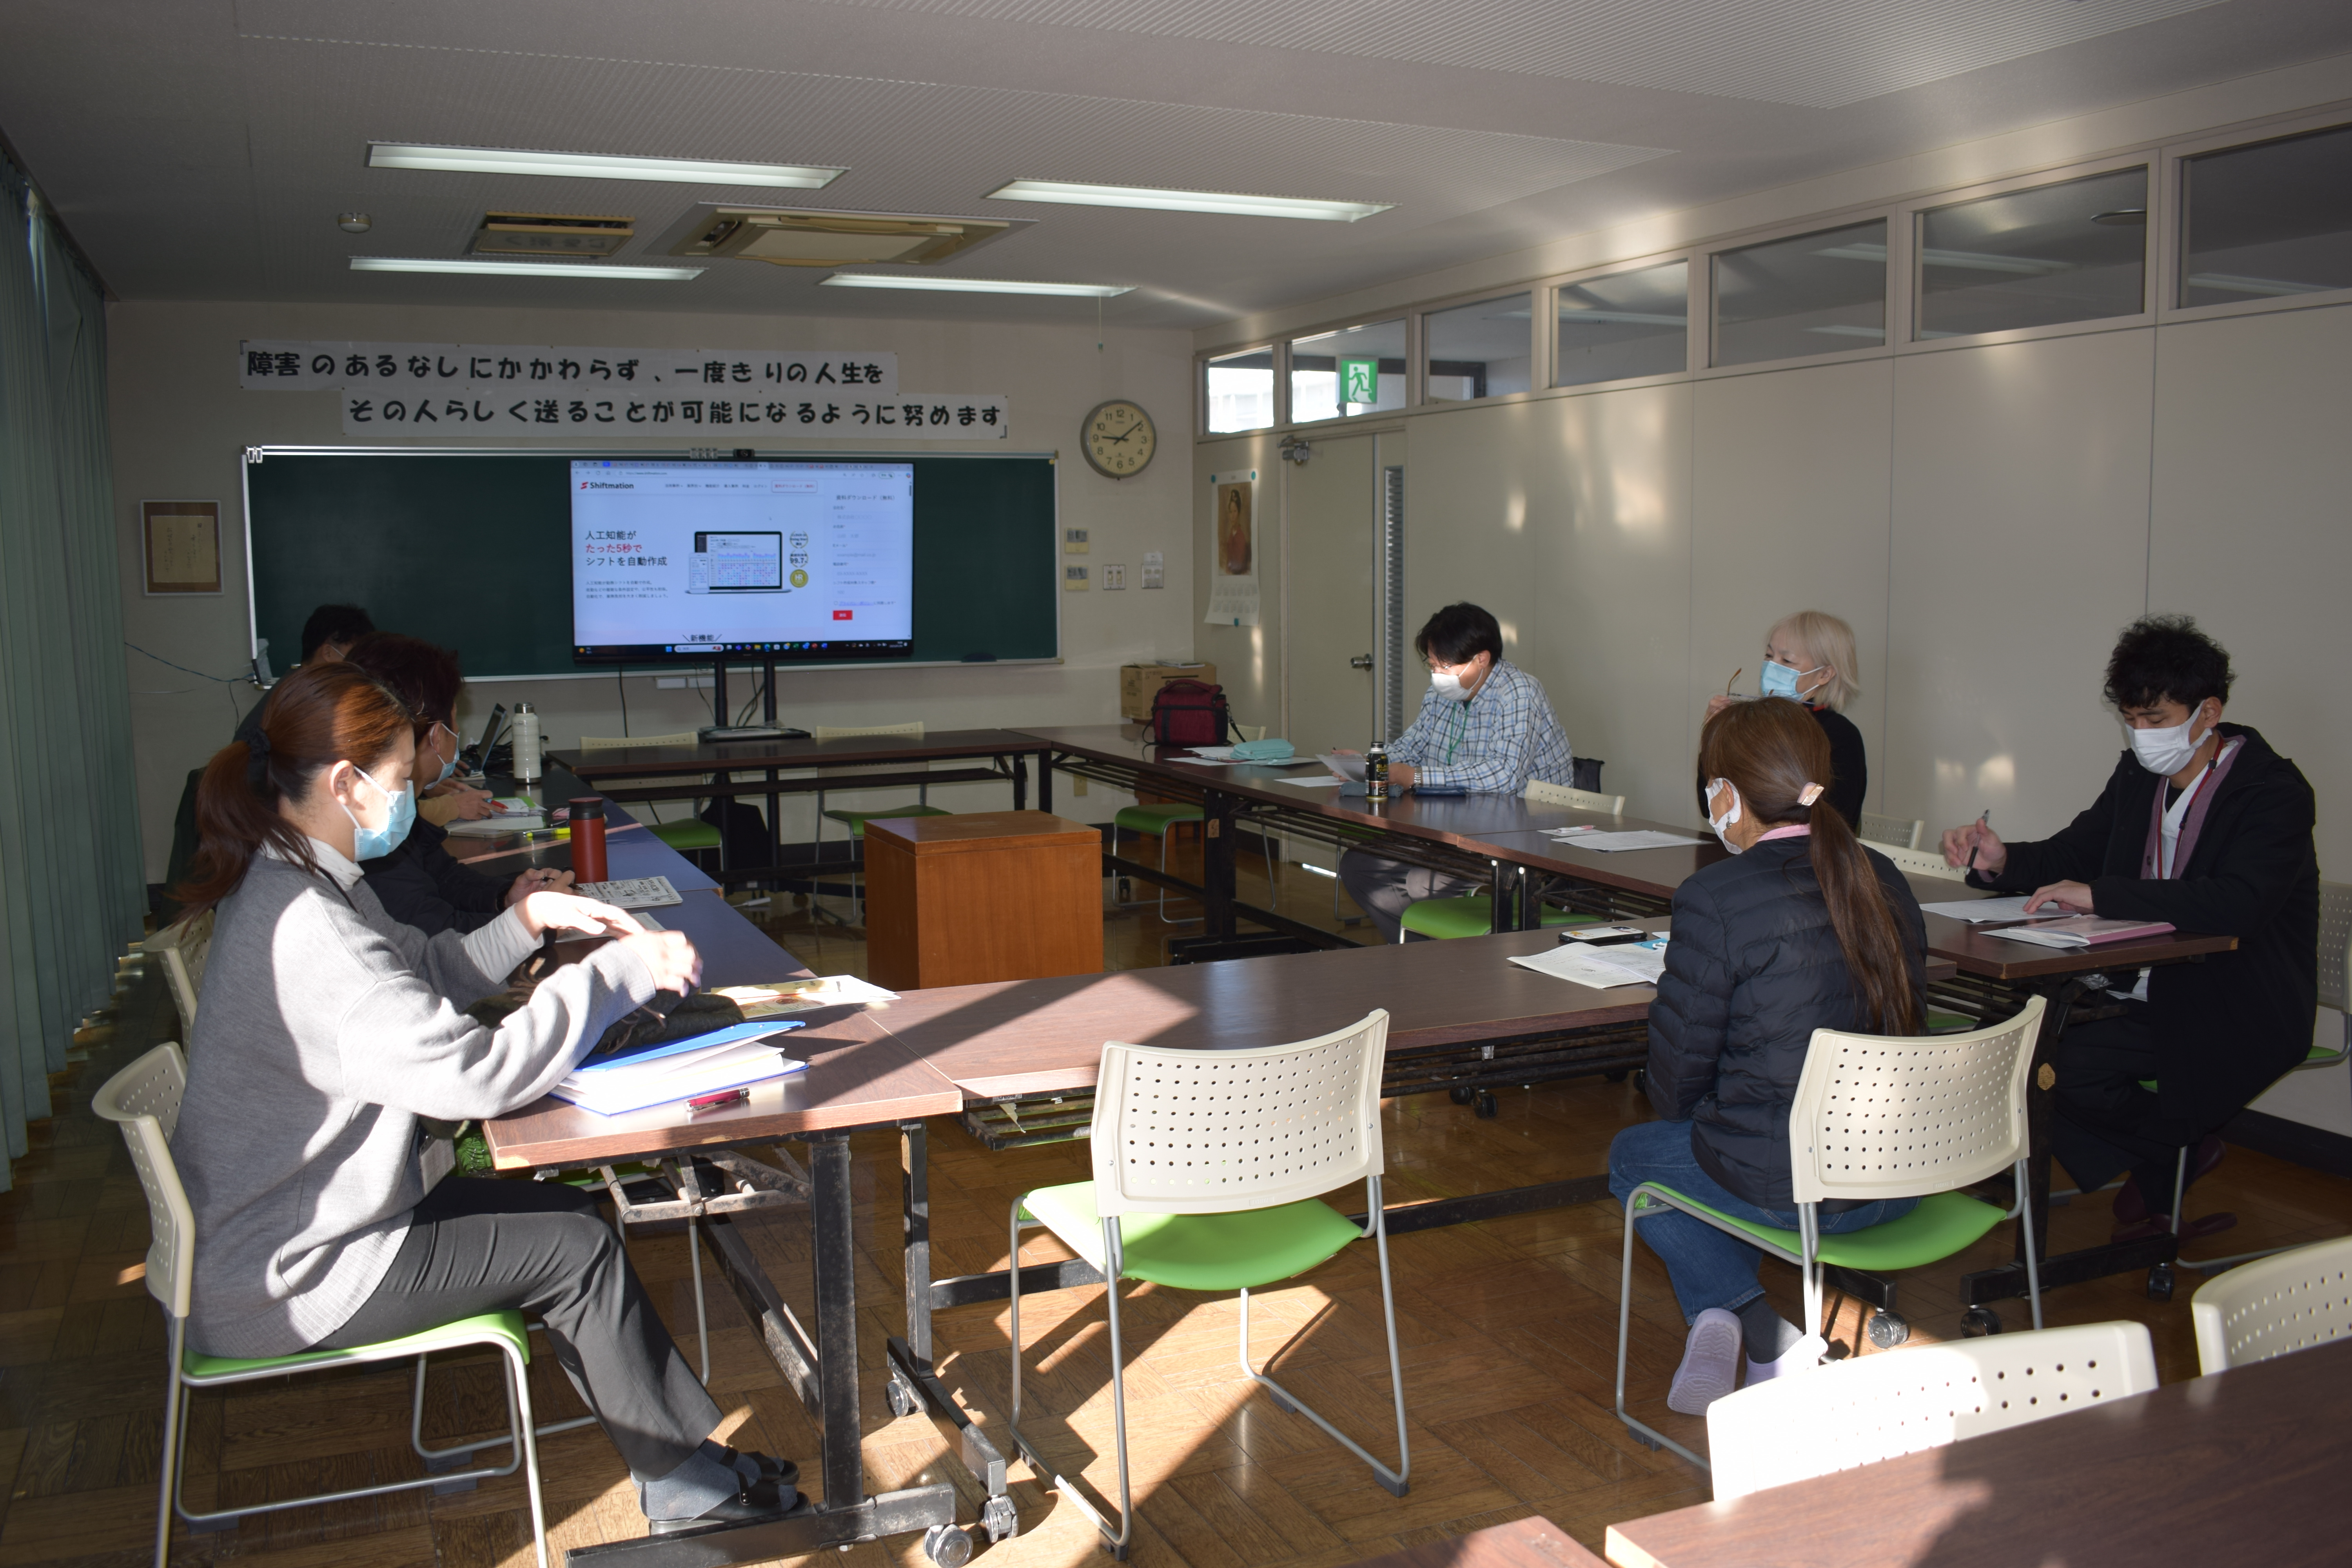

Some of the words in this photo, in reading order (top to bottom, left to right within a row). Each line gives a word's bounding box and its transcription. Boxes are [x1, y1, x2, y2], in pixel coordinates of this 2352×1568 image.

[1116, 409, 1125, 418] 12
[1097, 423, 1105, 431] 10
[1093, 434, 1099, 443] 9
[1141, 436, 1147, 444] 3
[1097, 446, 1103, 455] 8
[1106, 457, 1112, 465] 7
[1129, 457, 1134, 466] 5
[585, 530, 637, 540] 人工知能が
[586, 543, 642, 554] たった5秒で
[586, 556, 668, 566] シフトを自動作成
